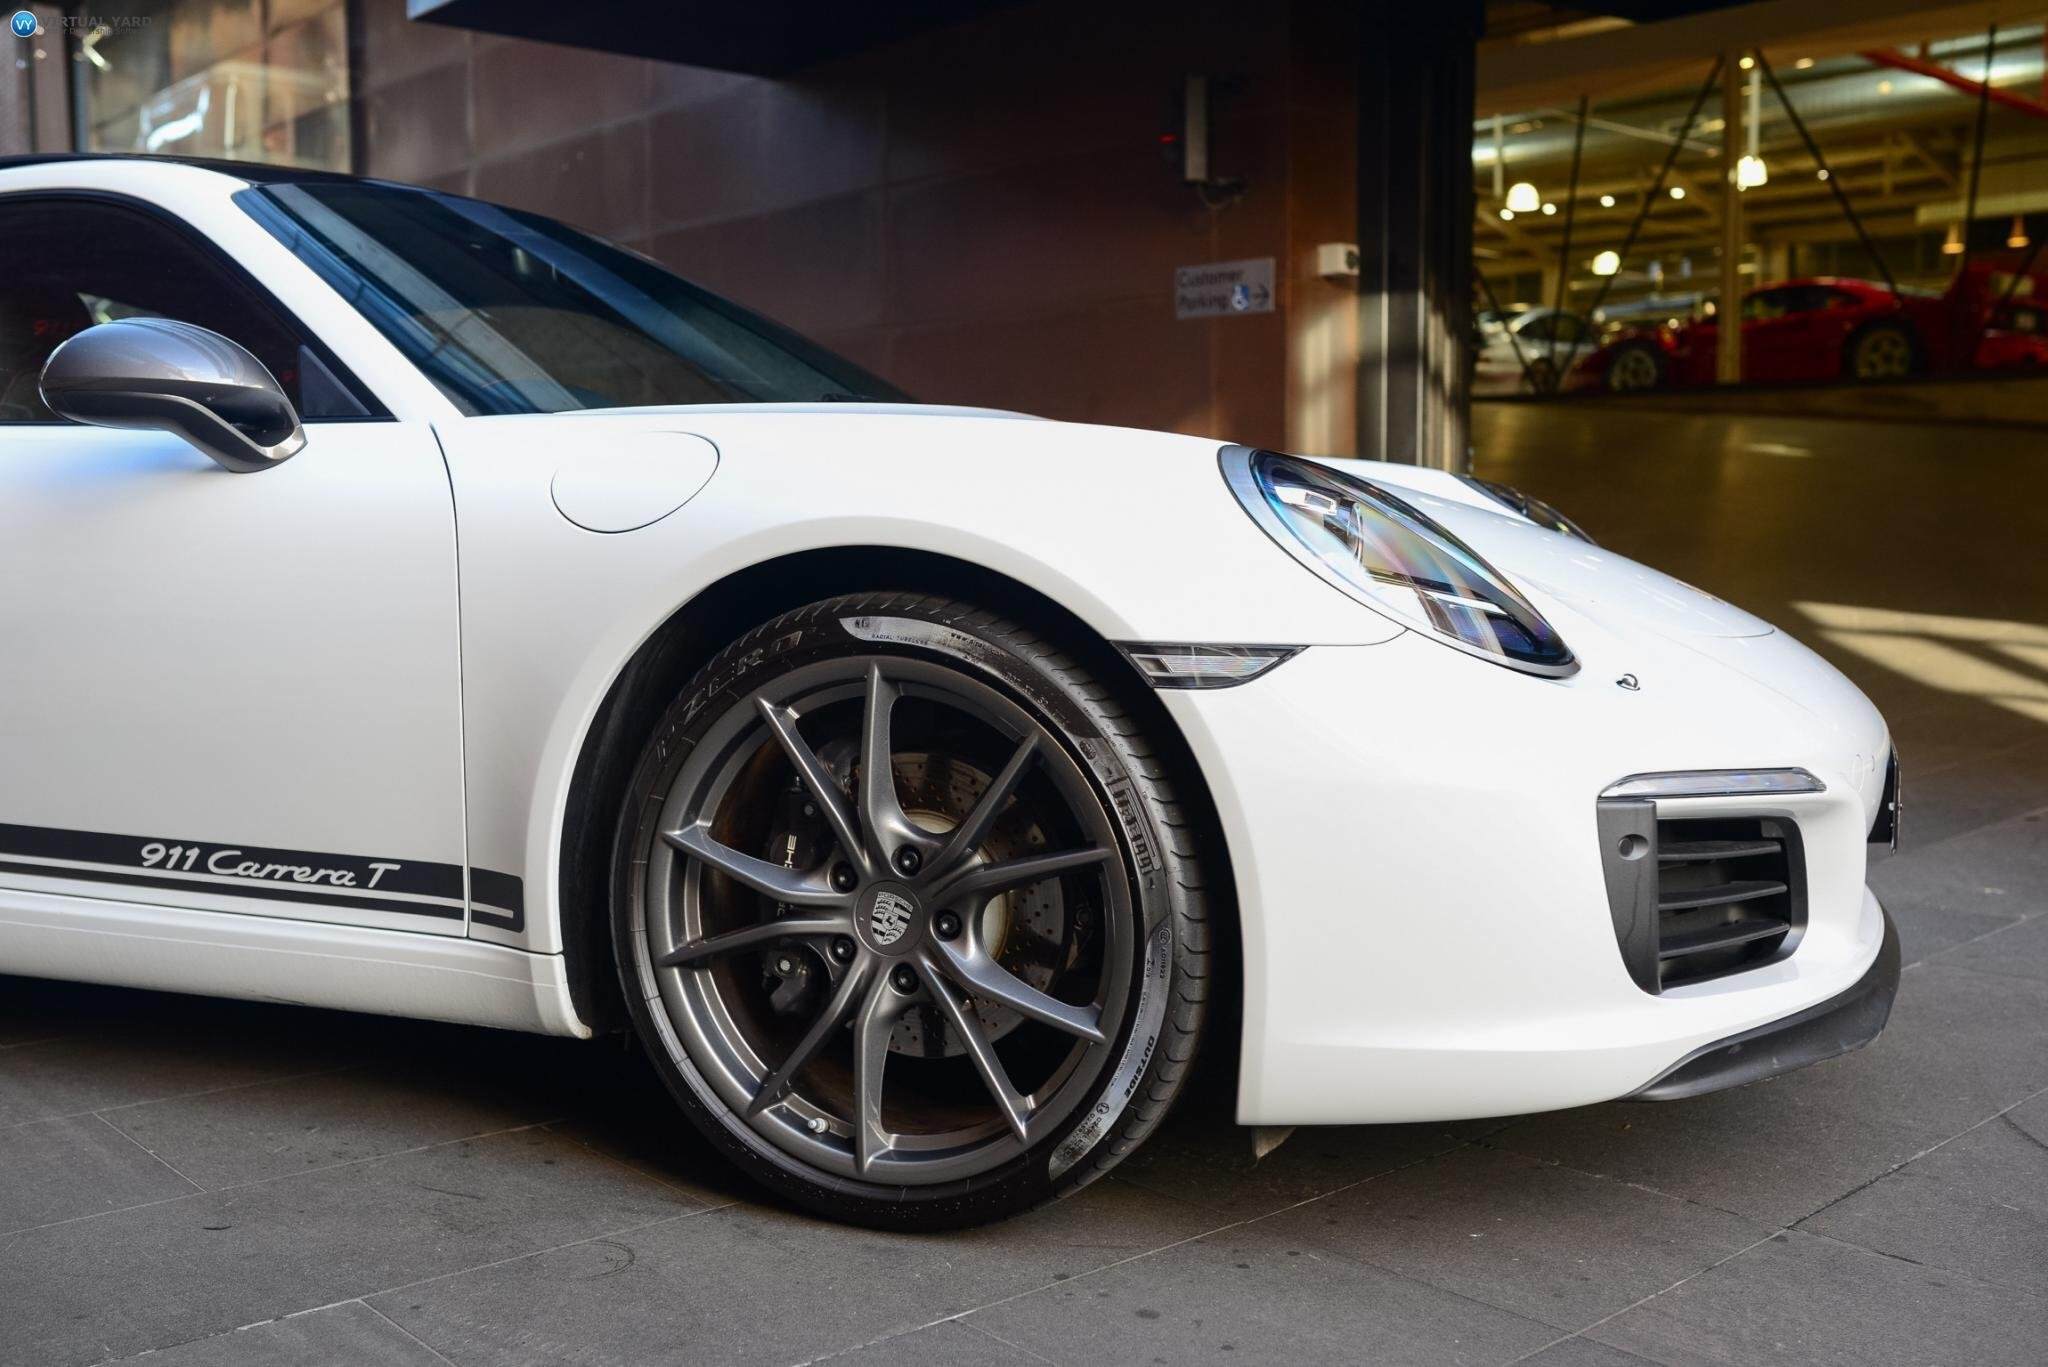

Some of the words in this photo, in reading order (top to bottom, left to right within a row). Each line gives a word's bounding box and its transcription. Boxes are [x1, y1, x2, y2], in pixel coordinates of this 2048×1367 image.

[141, 842, 200, 871] 911
[207, 849, 358, 887] Carrera
[367, 862, 402, 889] T
[1123, 1034, 1156, 1099] OUTSIDE
